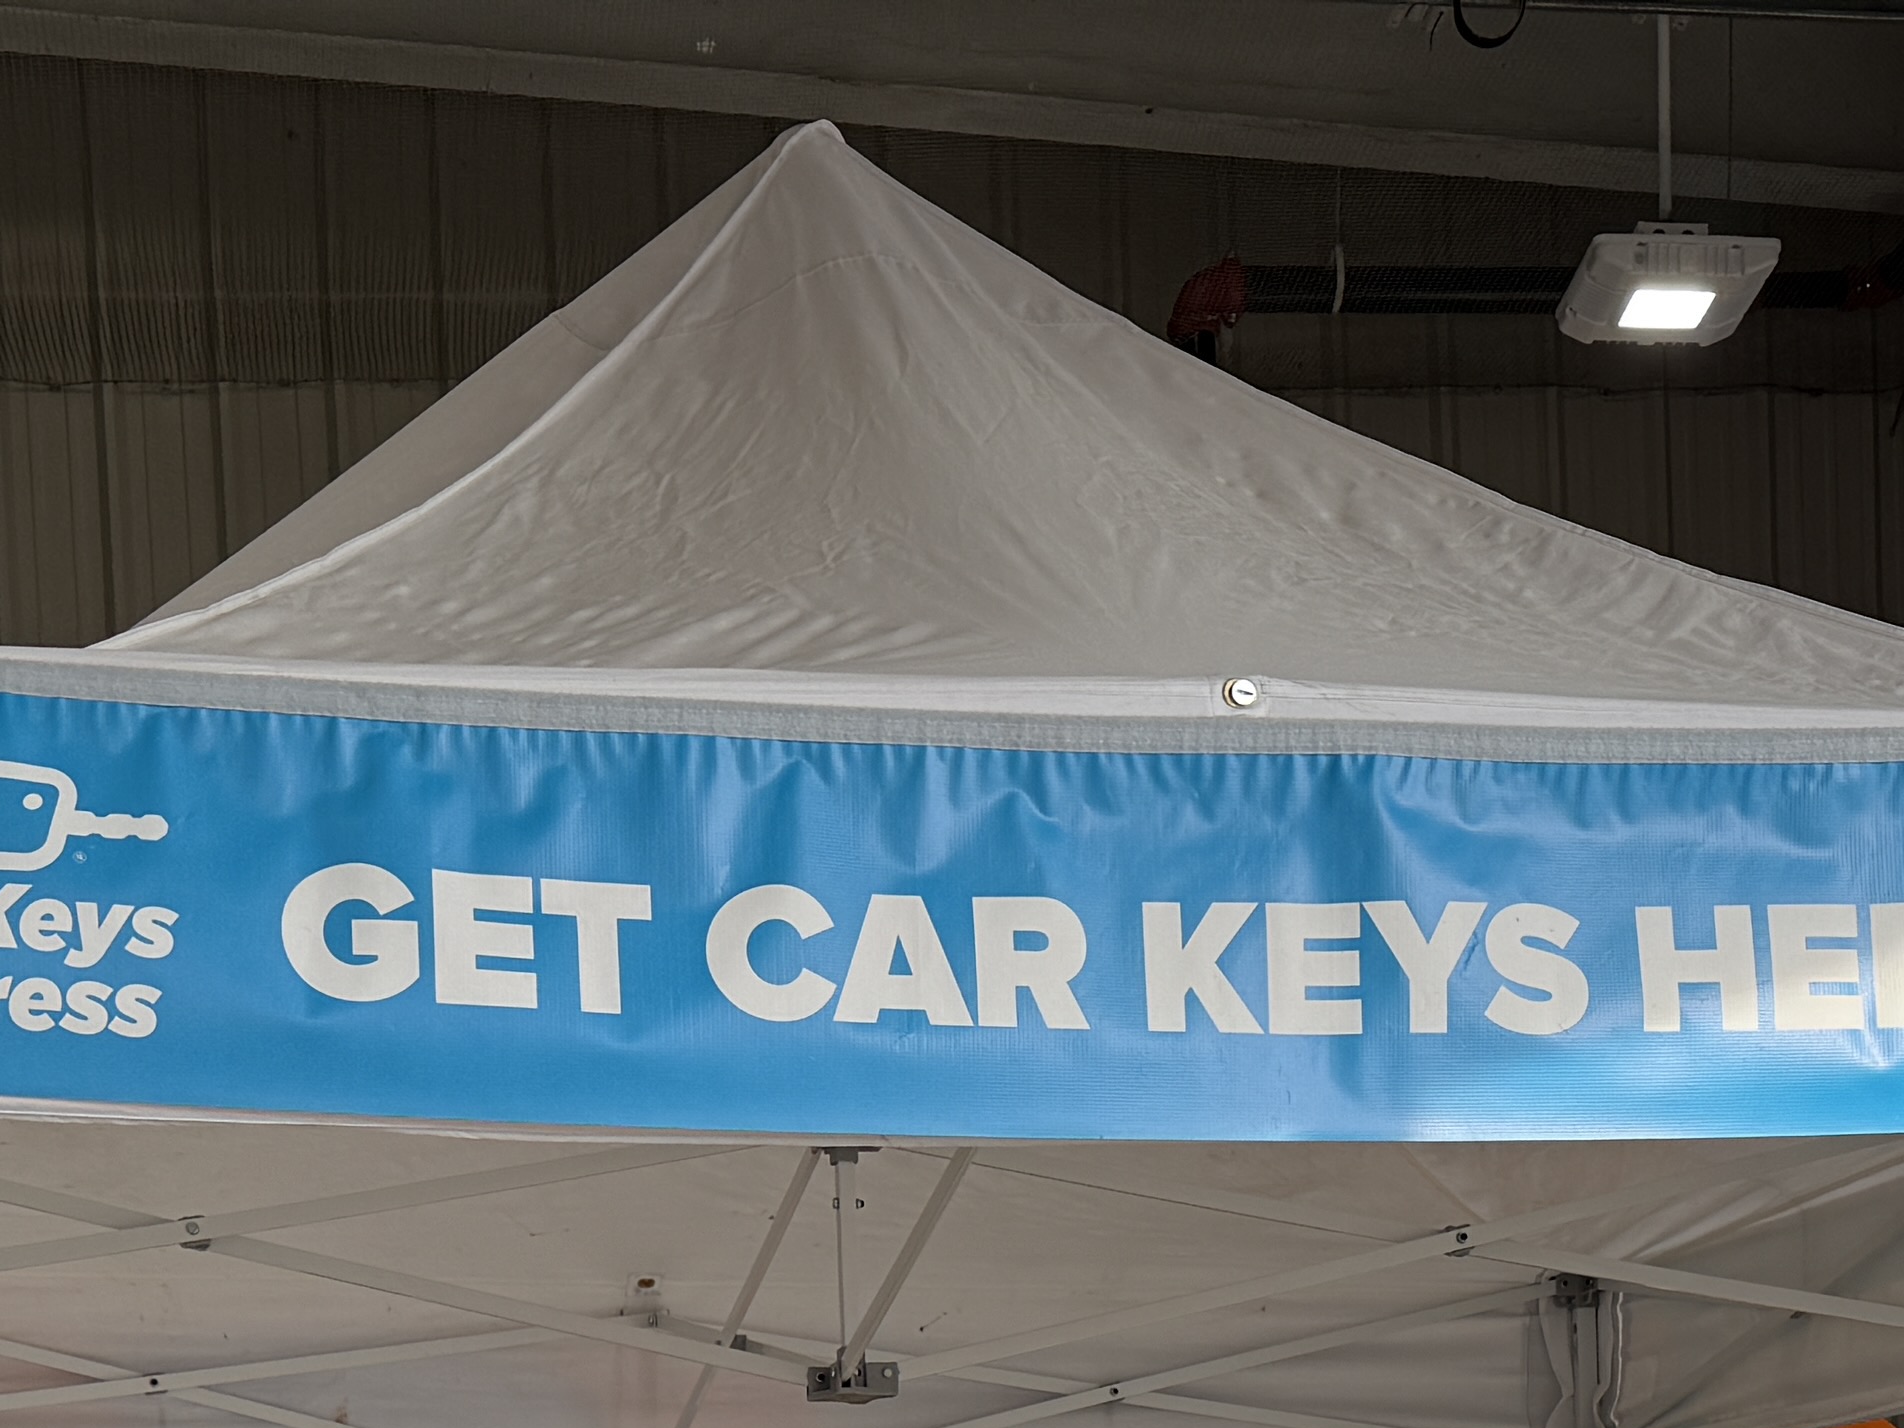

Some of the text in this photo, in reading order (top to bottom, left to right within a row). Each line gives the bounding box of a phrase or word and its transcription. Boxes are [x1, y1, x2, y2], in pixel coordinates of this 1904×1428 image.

[282, 862, 652, 1015] GET
[706, 884, 1090, 1030] CAR
[1141, 901, 1590, 1036] KEYS
